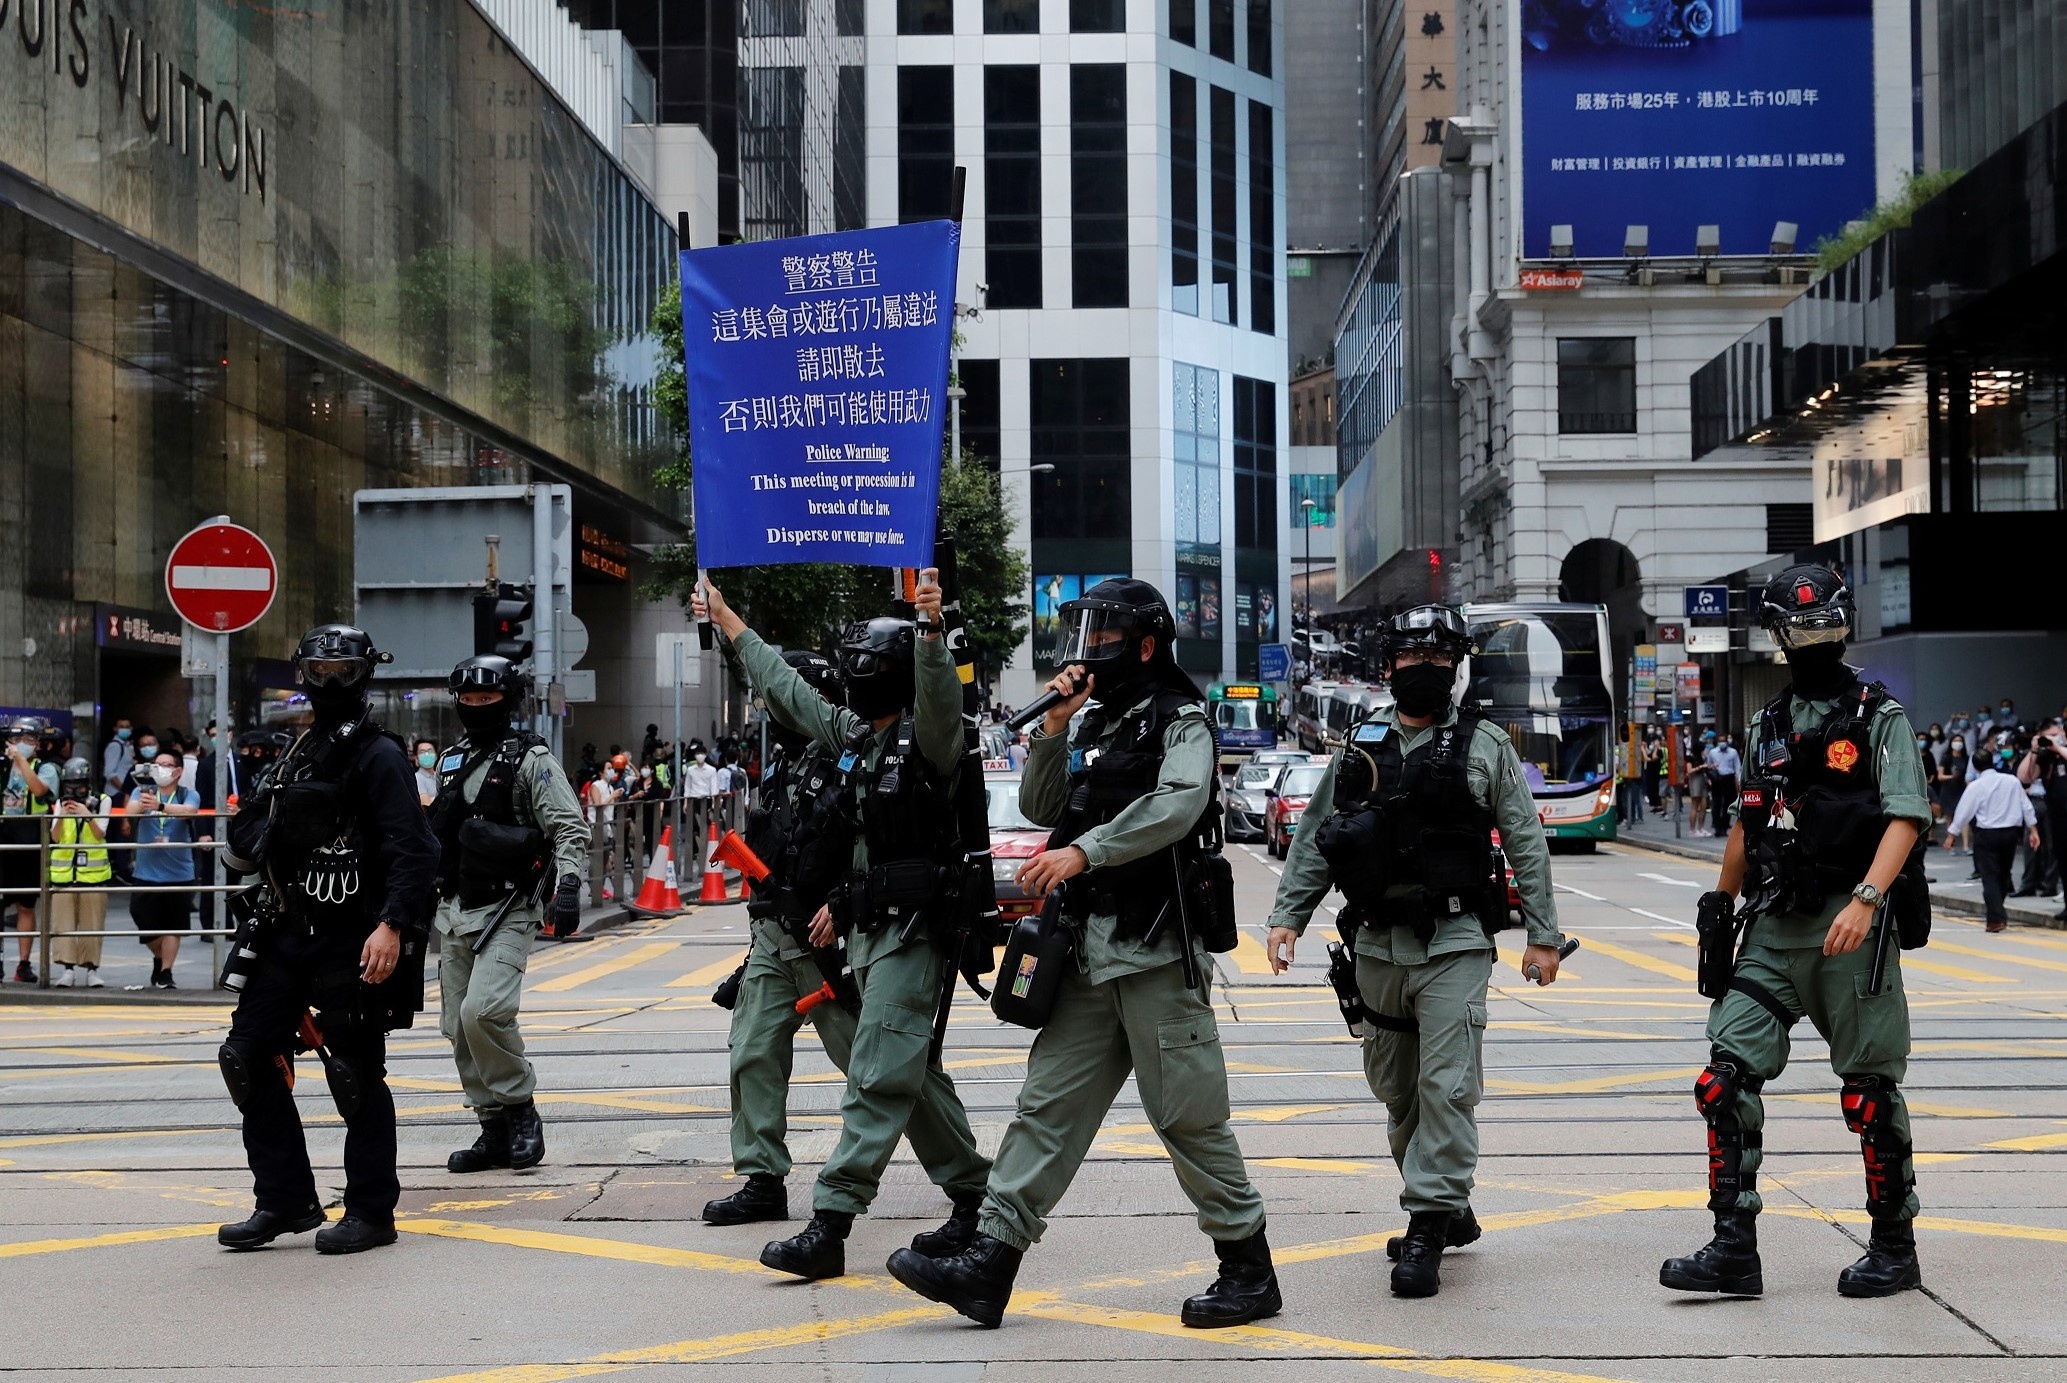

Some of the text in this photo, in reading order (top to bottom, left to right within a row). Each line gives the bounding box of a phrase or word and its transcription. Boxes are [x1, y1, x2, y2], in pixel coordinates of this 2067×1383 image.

[108, 15, 265, 207] VUITTON
[1551, 158, 1600, 171] 財富管理
[1613, 157, 1661, 170] 投資銀行
[1674, 156, 1722, 169] 資產管理
[1735, 154, 1784, 168] 金融產品
[782, 249, 878, 291] 警察警告
[1537, 272, 1583, 289] Asiaray
[712, 291, 938, 342] 這集會或遊行乃屬違法
[796, 343, 885, 382] 請即散去
[719, 388, 930, 433] 否則我們可能使用武力
[806, 443, 890, 464] Police Warning:
[750, 471, 915, 491] This meeting or procession is in
[808, 499, 890, 516] breach of the law.
[767, 527, 905, 547] Disperse or we may use force.
[809, 658, 829, 667] POLICE
[983, 761, 1008, 770] TAXI
